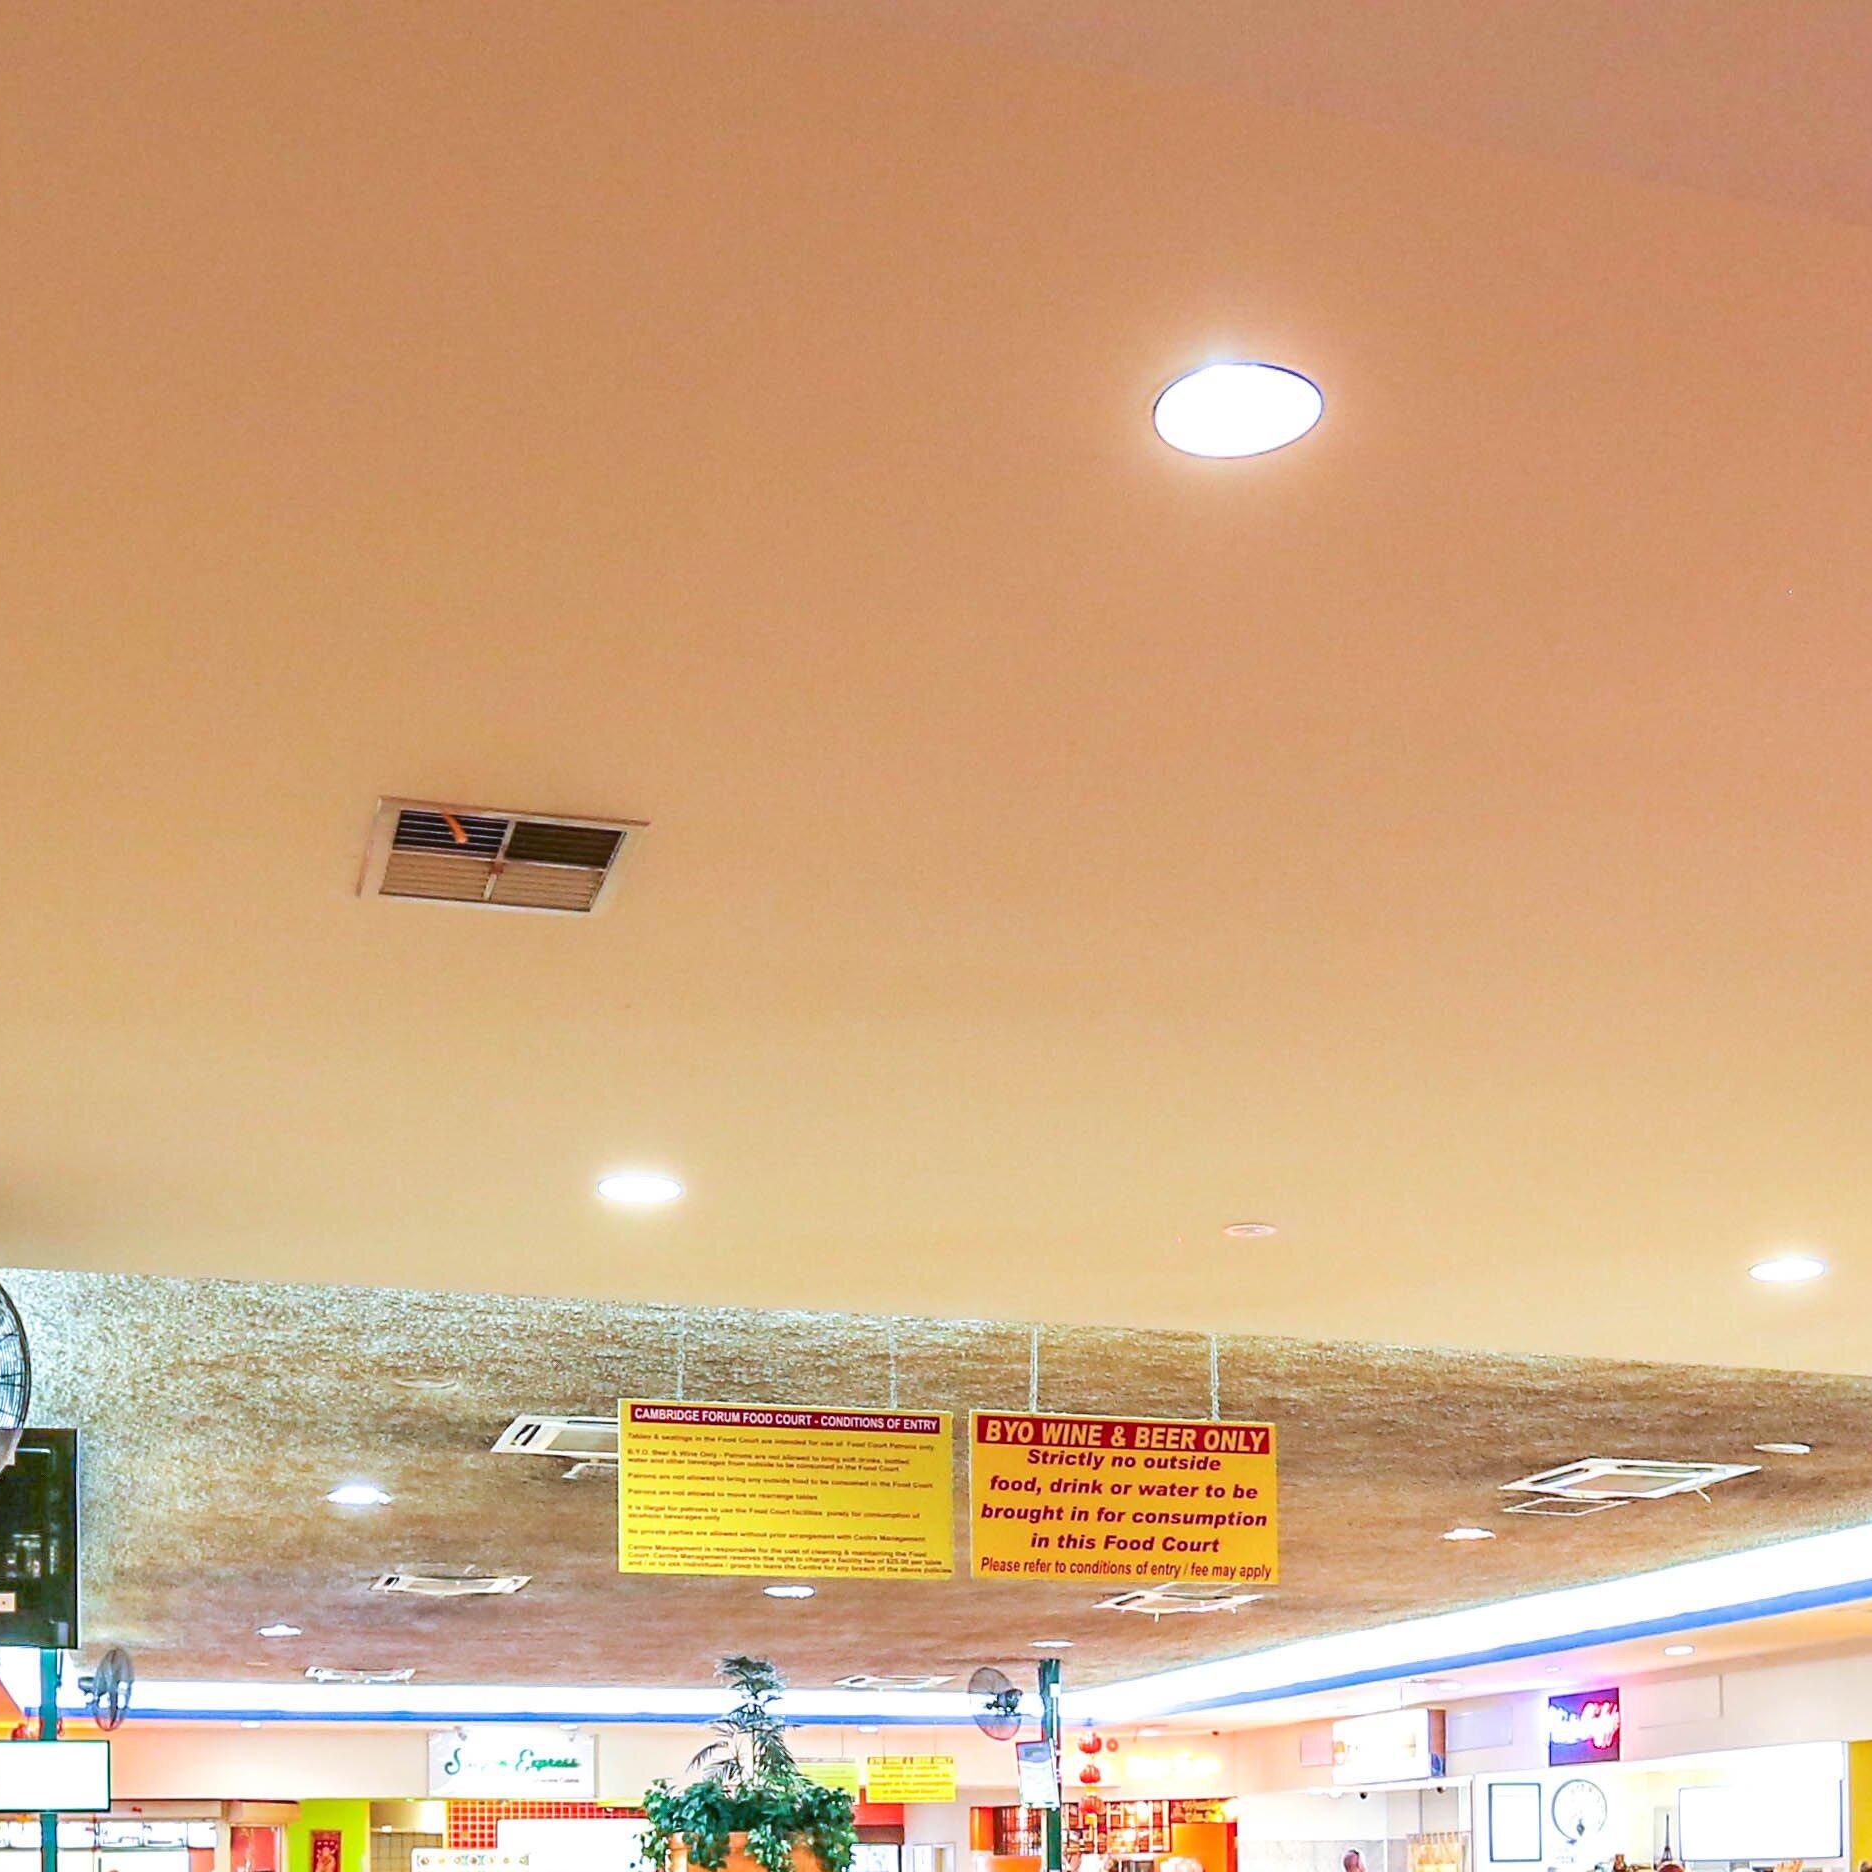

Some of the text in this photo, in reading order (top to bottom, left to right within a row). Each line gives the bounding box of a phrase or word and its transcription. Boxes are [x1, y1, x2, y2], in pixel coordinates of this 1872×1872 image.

[634, 1407, 700, 1422] CAMBRIDGE
[702, 1410, 741, 1423] FORUM
[743, 1412, 773, 1425] FOOD
[775, 1413, 812, 1426] COURT
[820, 1415, 884, 1429] CONDITIONS
[886, 1418, 901, 1429] OF
[903, 1419, 938, 1431] ENTRY
[985, 1420, 1266, 1452] BYO WINE & BEER ONLY
[1027, 1449, 1221, 1471] Strictly no outside
[990, 1475, 1258, 1499] food, drink or water to be
[981, 1503, 1267, 1529] brought in for consumption
[1031, 1533, 1220, 1553] in this Food Court
[981, 1557, 1020, 1571] Please
[1024, 1558, 1052, 1572] refer
[1055, 1560, 1066, 1573] to
[1070, 1560, 1131, 1575] conditions
[1136, 1561, 1149, 1575] of
[1151, 1563, 1181, 1579] entry
[1191, 1562, 1208, 1576] fee
[1212, 1566, 1236, 1579] may
[1239, 1564, 1272, 1581] apply
